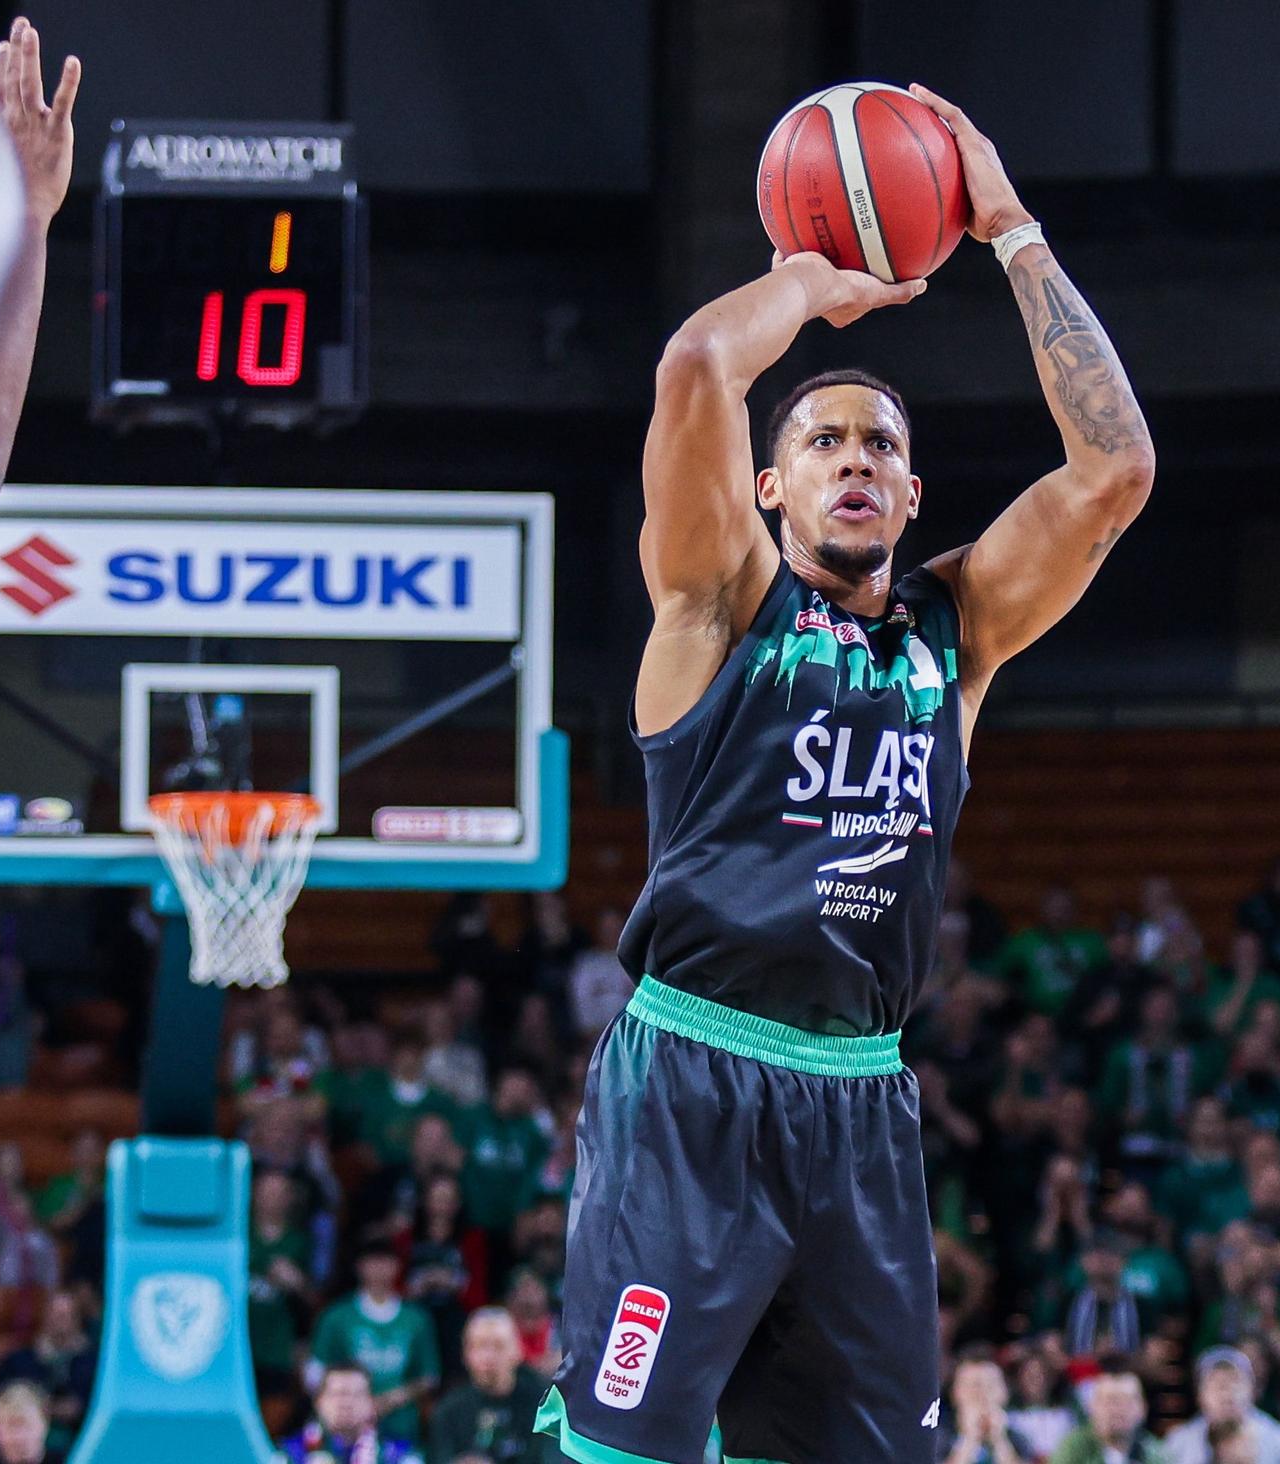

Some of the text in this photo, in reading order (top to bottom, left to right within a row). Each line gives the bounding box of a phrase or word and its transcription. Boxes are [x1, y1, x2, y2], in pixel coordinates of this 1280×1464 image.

[270, 211, 292, 273] 1
[197, 288, 307, 386] 10
[107, 552, 471, 608] SUZUKI
[831, 809, 919, 838] WROCŁAW
[815, 878, 898, 907] WROCLAW
[820, 900, 884, 923] AIRPORT
[624, 1301, 663, 1320] ORLEN
[603, 1369, 640, 1389] Basket
[606, 1382, 629, 1398] Liga
